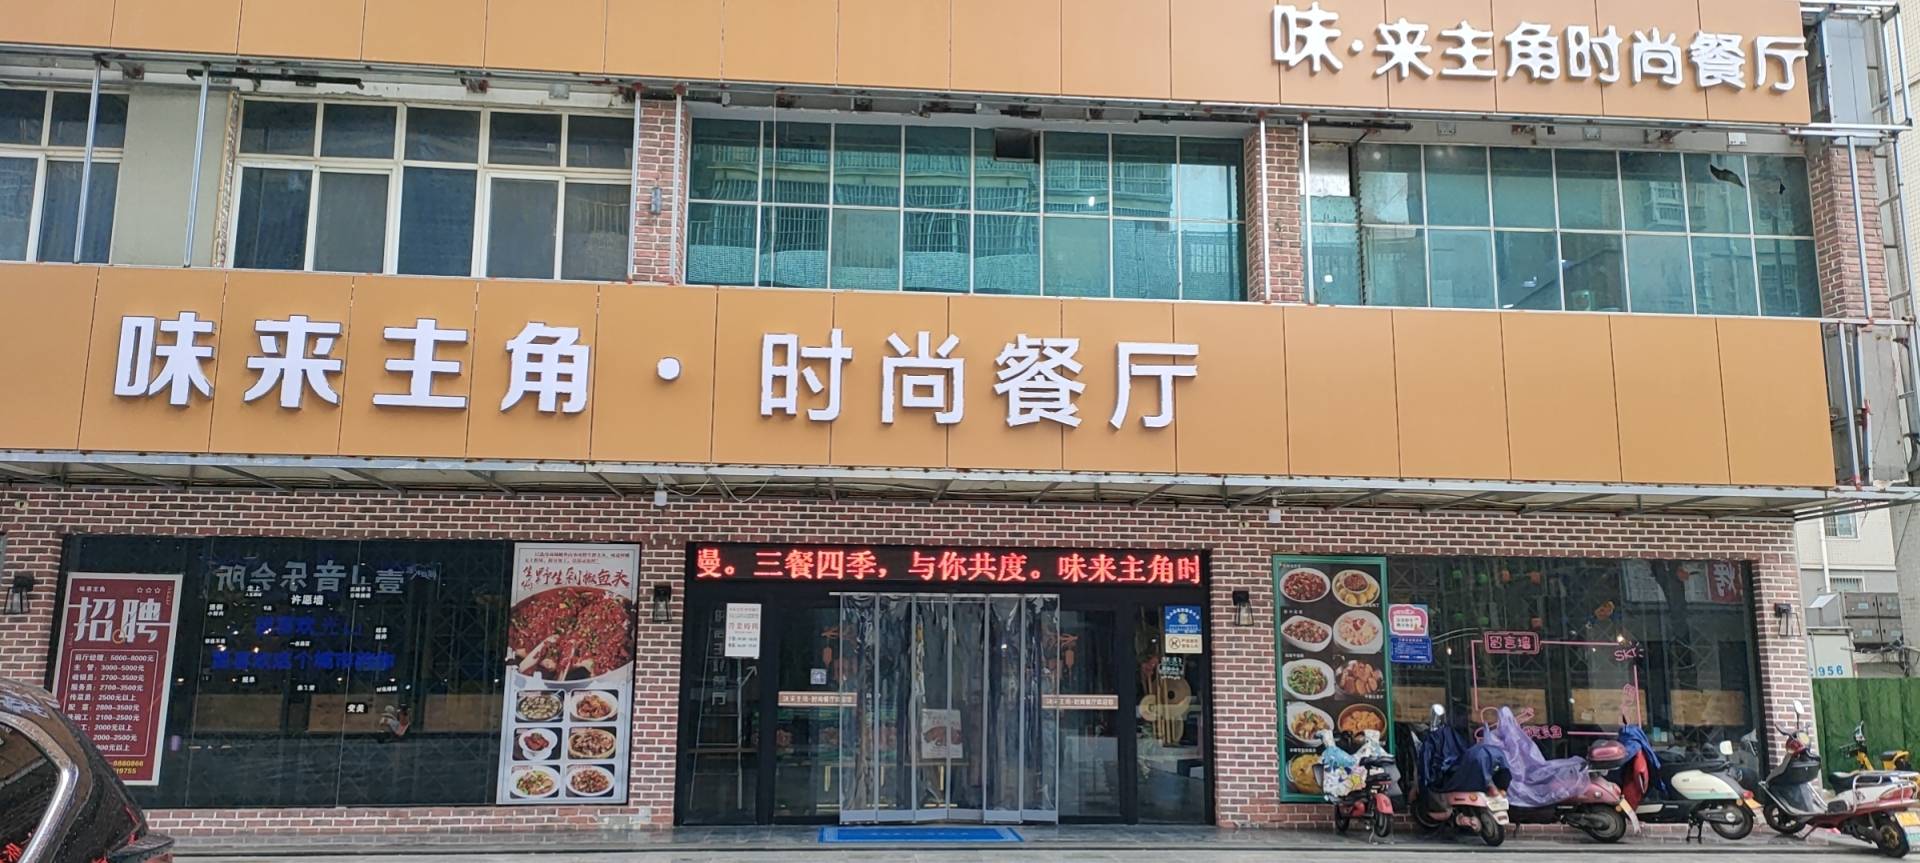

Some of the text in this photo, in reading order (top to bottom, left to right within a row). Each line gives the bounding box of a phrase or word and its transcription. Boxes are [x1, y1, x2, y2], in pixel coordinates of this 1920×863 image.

[1272, 2, 1808, 92] 味·来主角时尚餐厅
[73, 597, 162, 643] 招聘
[291, 595, 324, 606] 许愿墙
